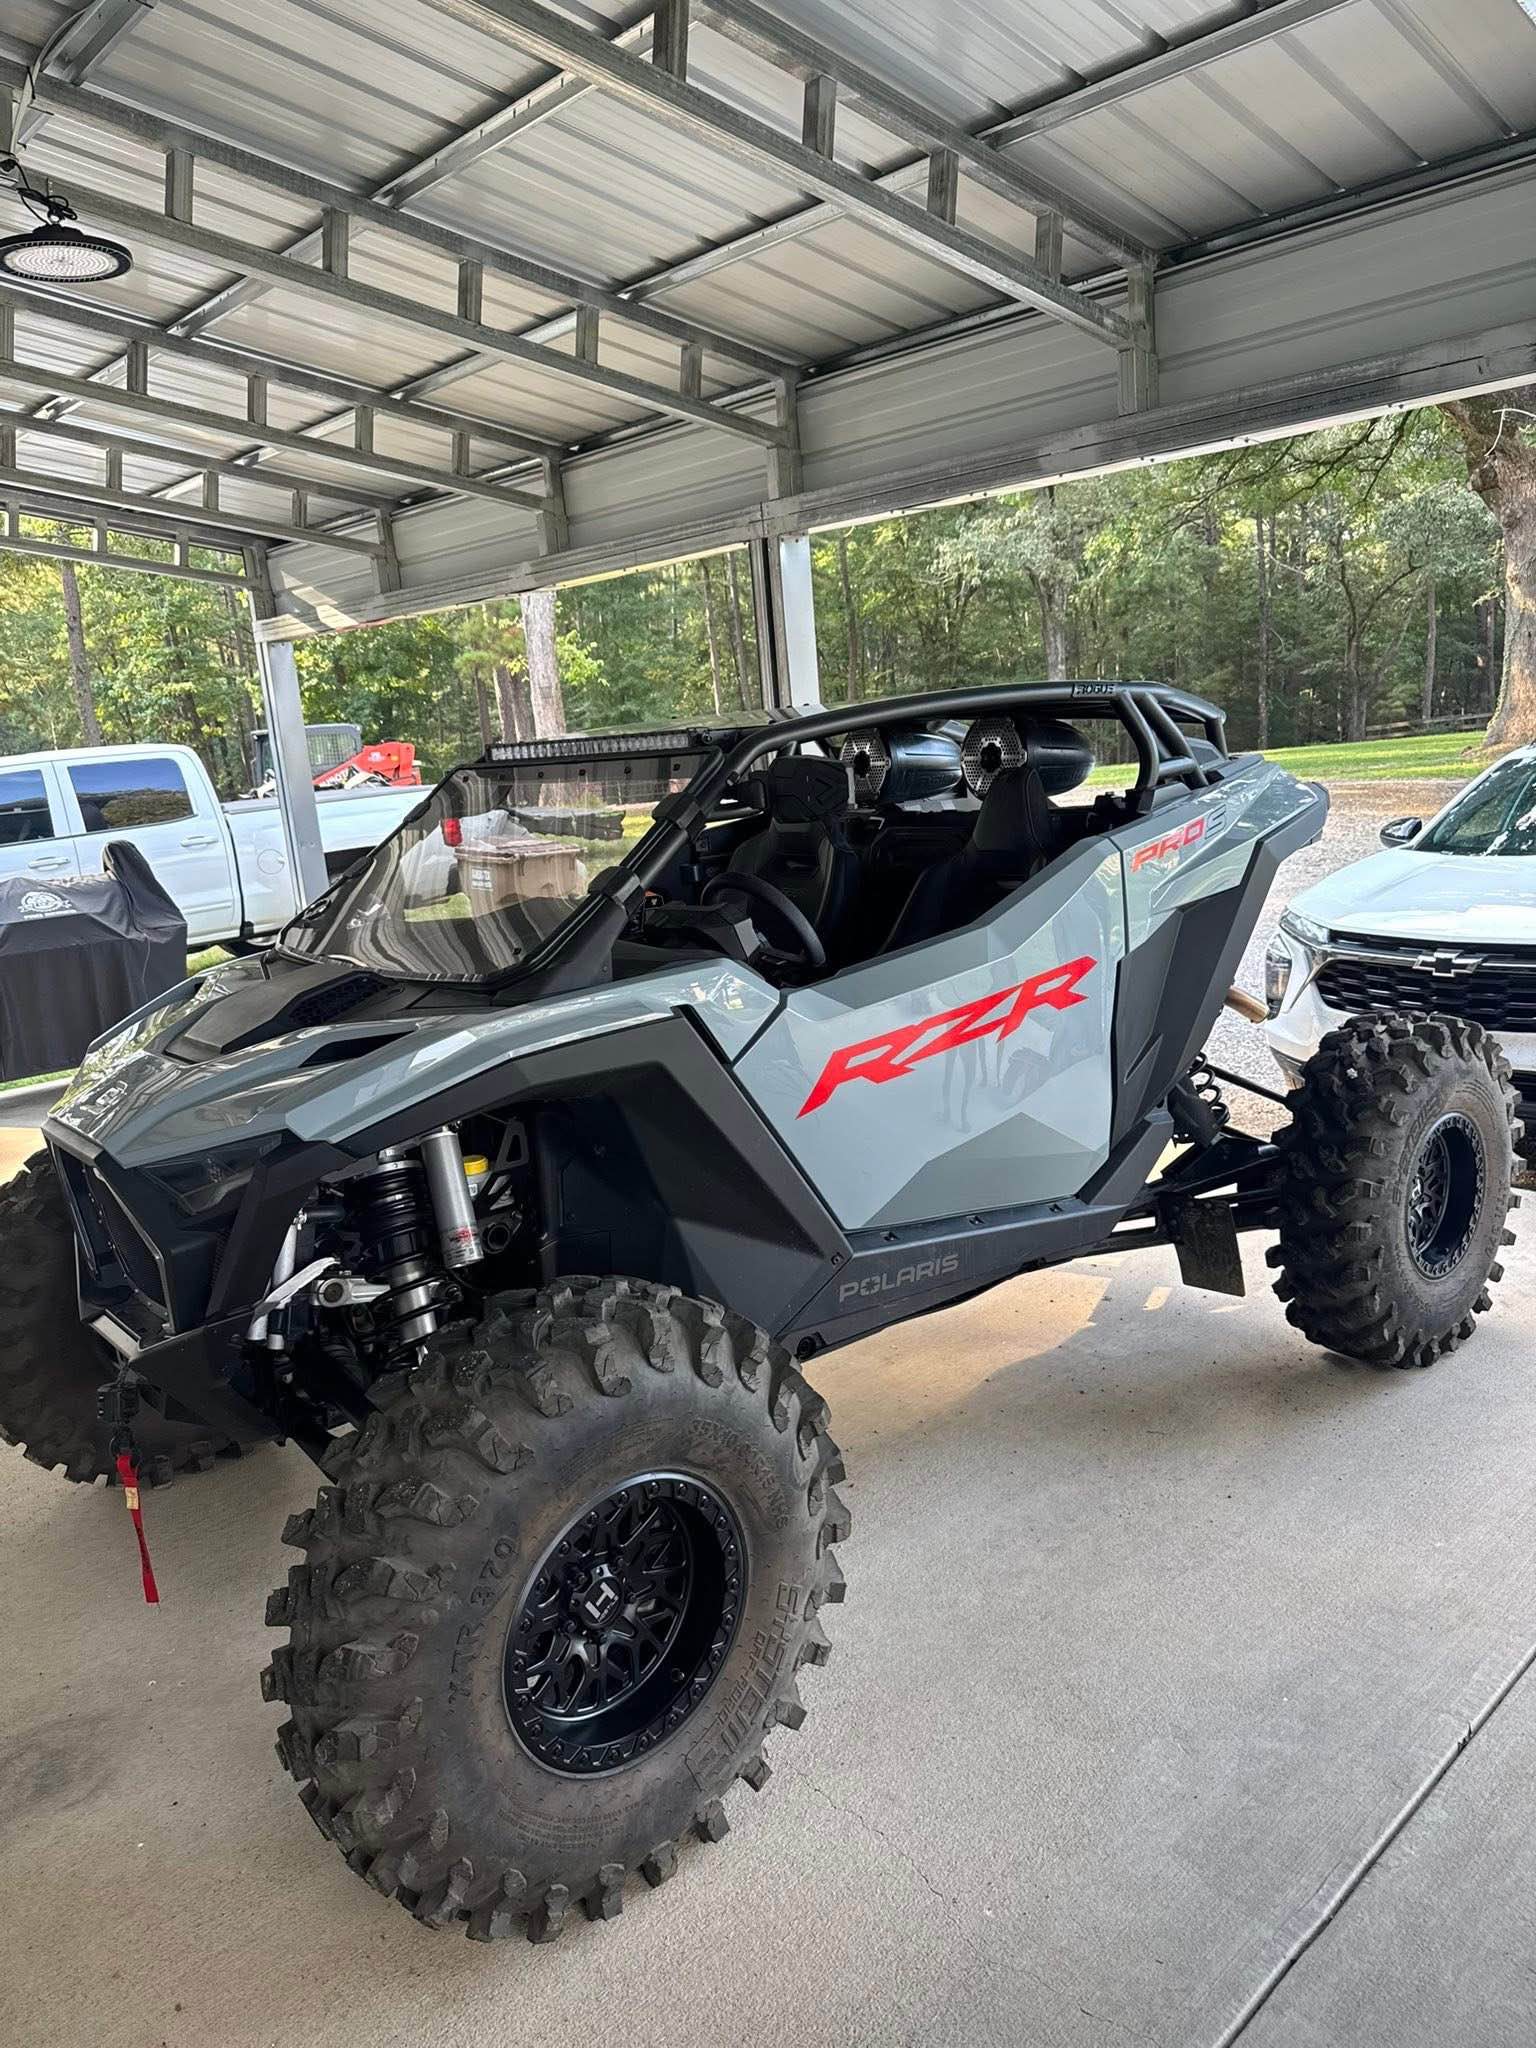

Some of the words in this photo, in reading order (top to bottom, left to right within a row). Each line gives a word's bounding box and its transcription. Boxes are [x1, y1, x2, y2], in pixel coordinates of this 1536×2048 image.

[1130, 815, 1205, 873] PRO
[795, 955, 1099, 1121] RZR
[839, 1253, 959, 1303] POLARIS
[469, 1535, 517, 1606] 370
